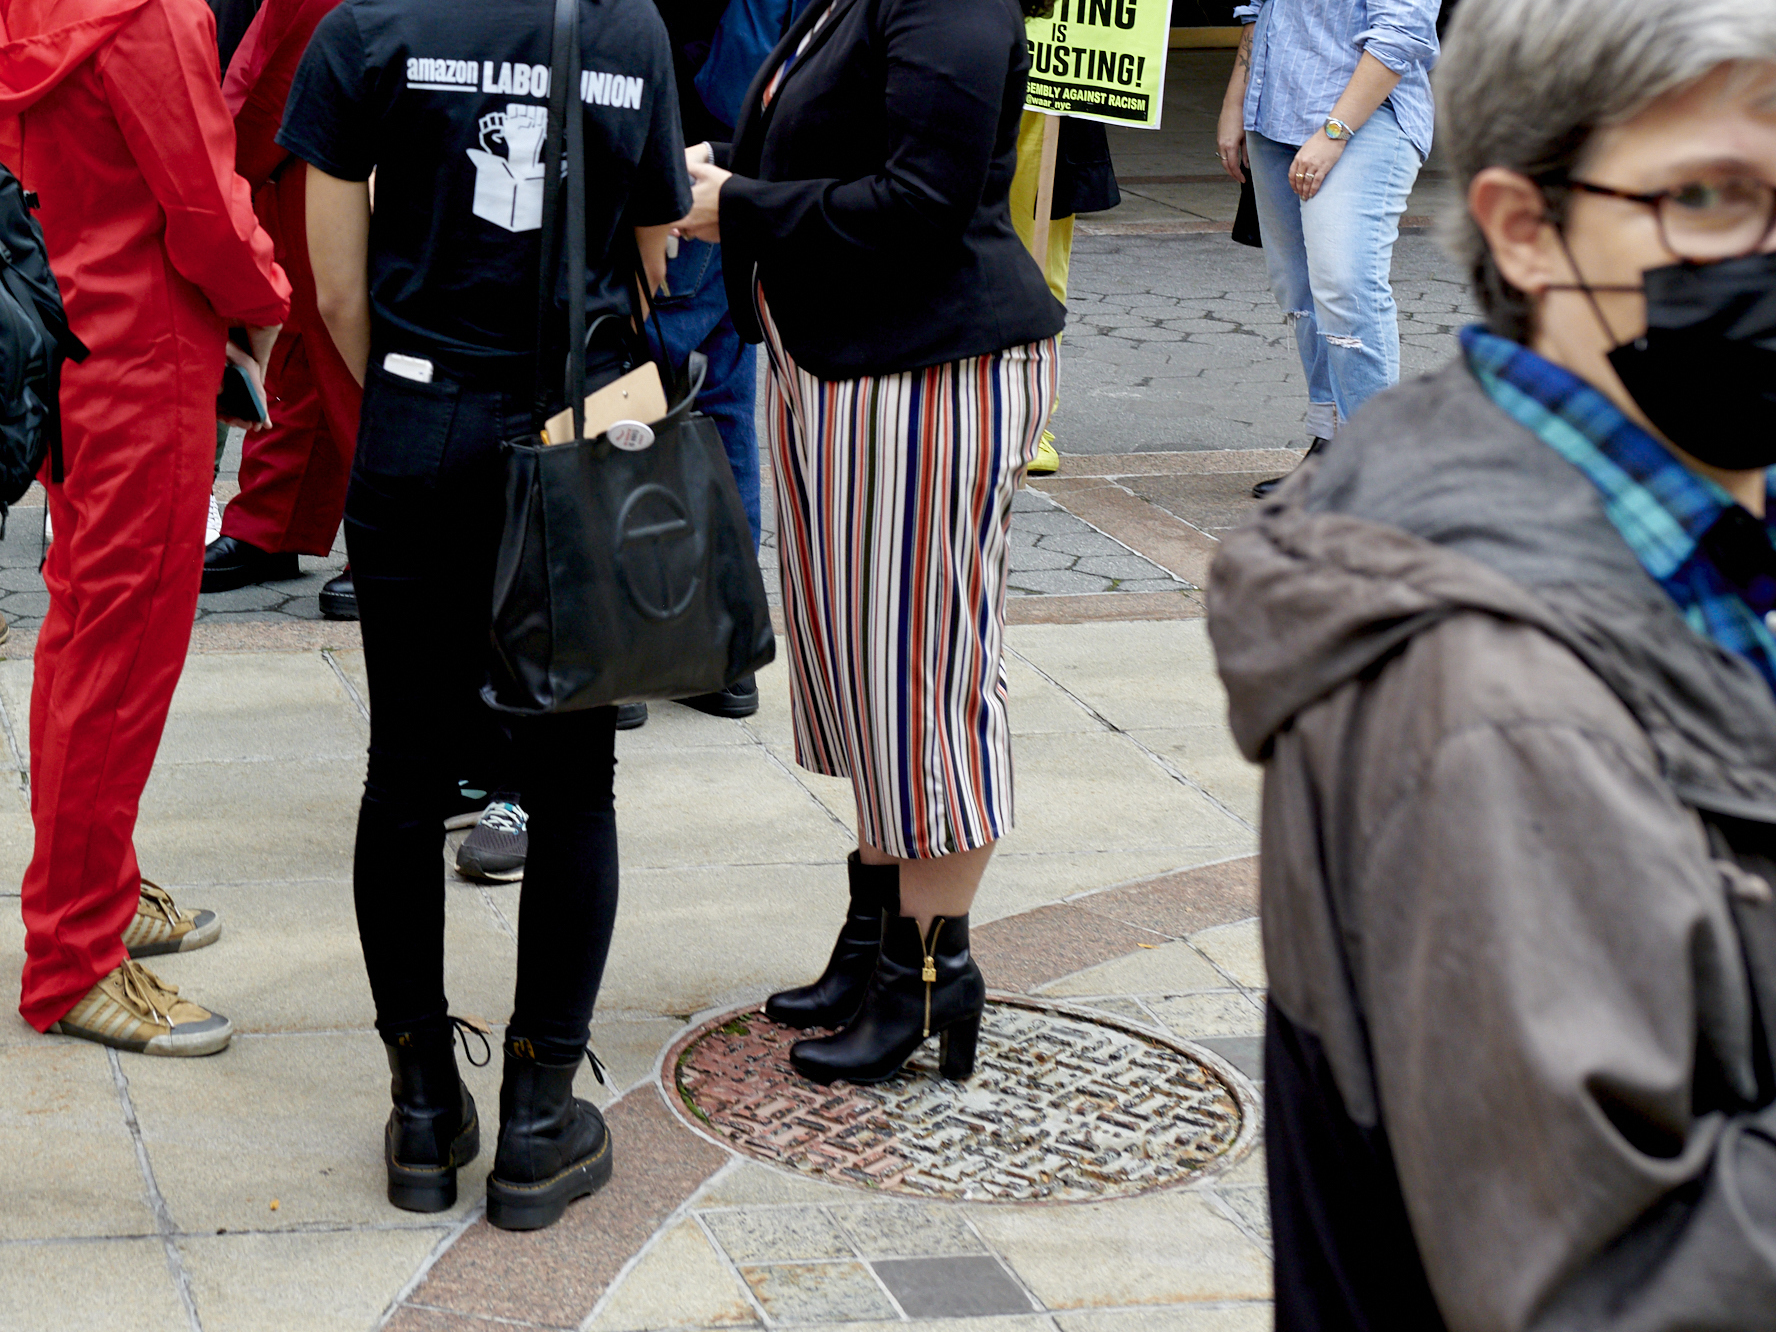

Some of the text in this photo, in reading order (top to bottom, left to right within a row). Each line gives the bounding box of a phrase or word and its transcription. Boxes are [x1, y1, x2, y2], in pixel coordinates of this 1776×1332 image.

[1051, 23, 1067, 43] IS
[406, 57, 479, 85] amazon
[482, 60, 552, 99] LABO
[1062, 88, 1107, 106] AGAINST
[1108, 94, 1146, 111] RACISM
